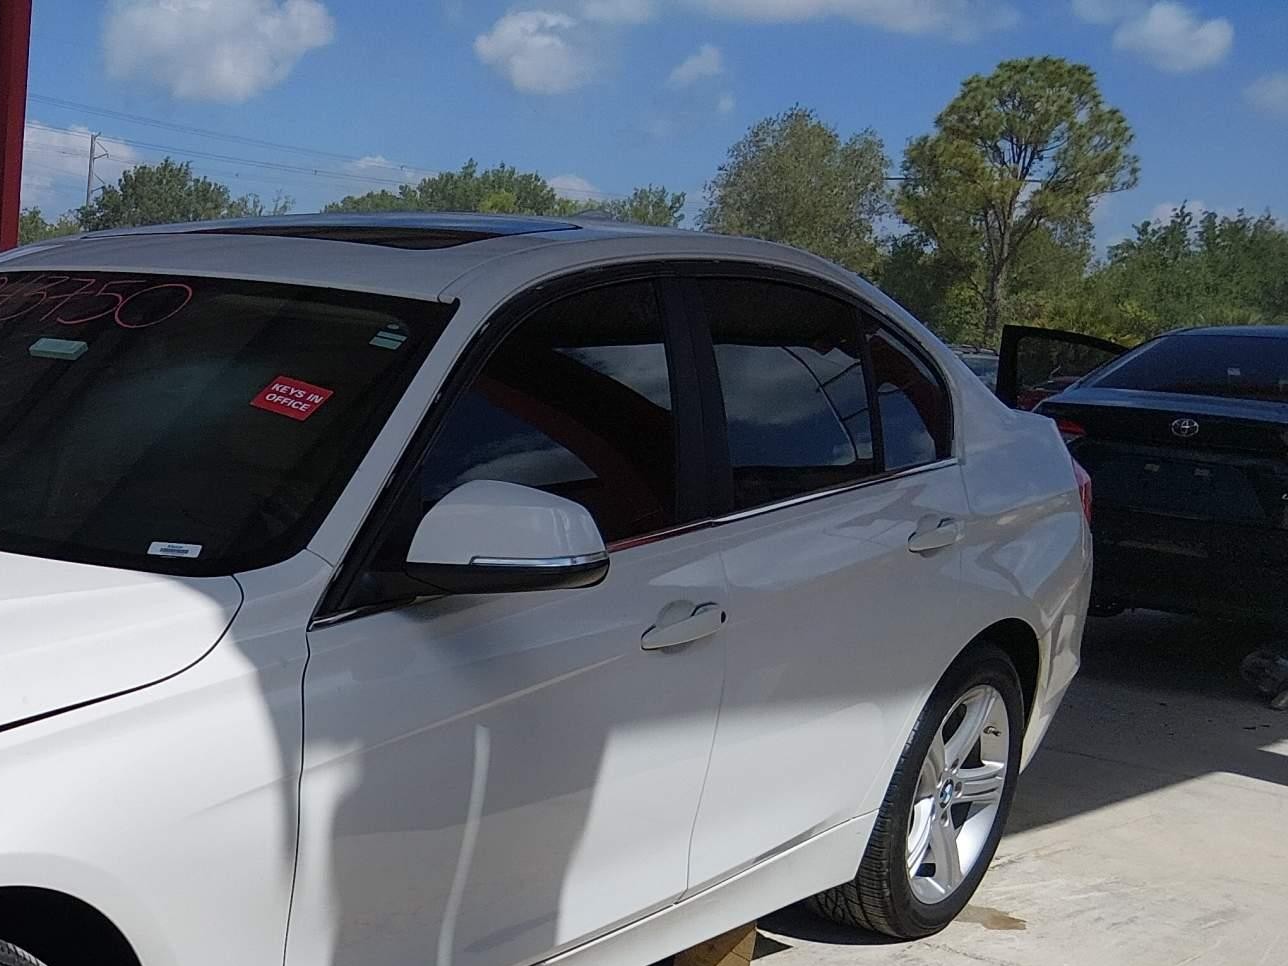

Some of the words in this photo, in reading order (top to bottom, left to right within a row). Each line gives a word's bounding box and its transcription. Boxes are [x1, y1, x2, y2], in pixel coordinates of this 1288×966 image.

[265, 393, 311, 412] OFFICE
[271, 383, 307, 399] KEYS
[306, 393, 324, 404] IN
